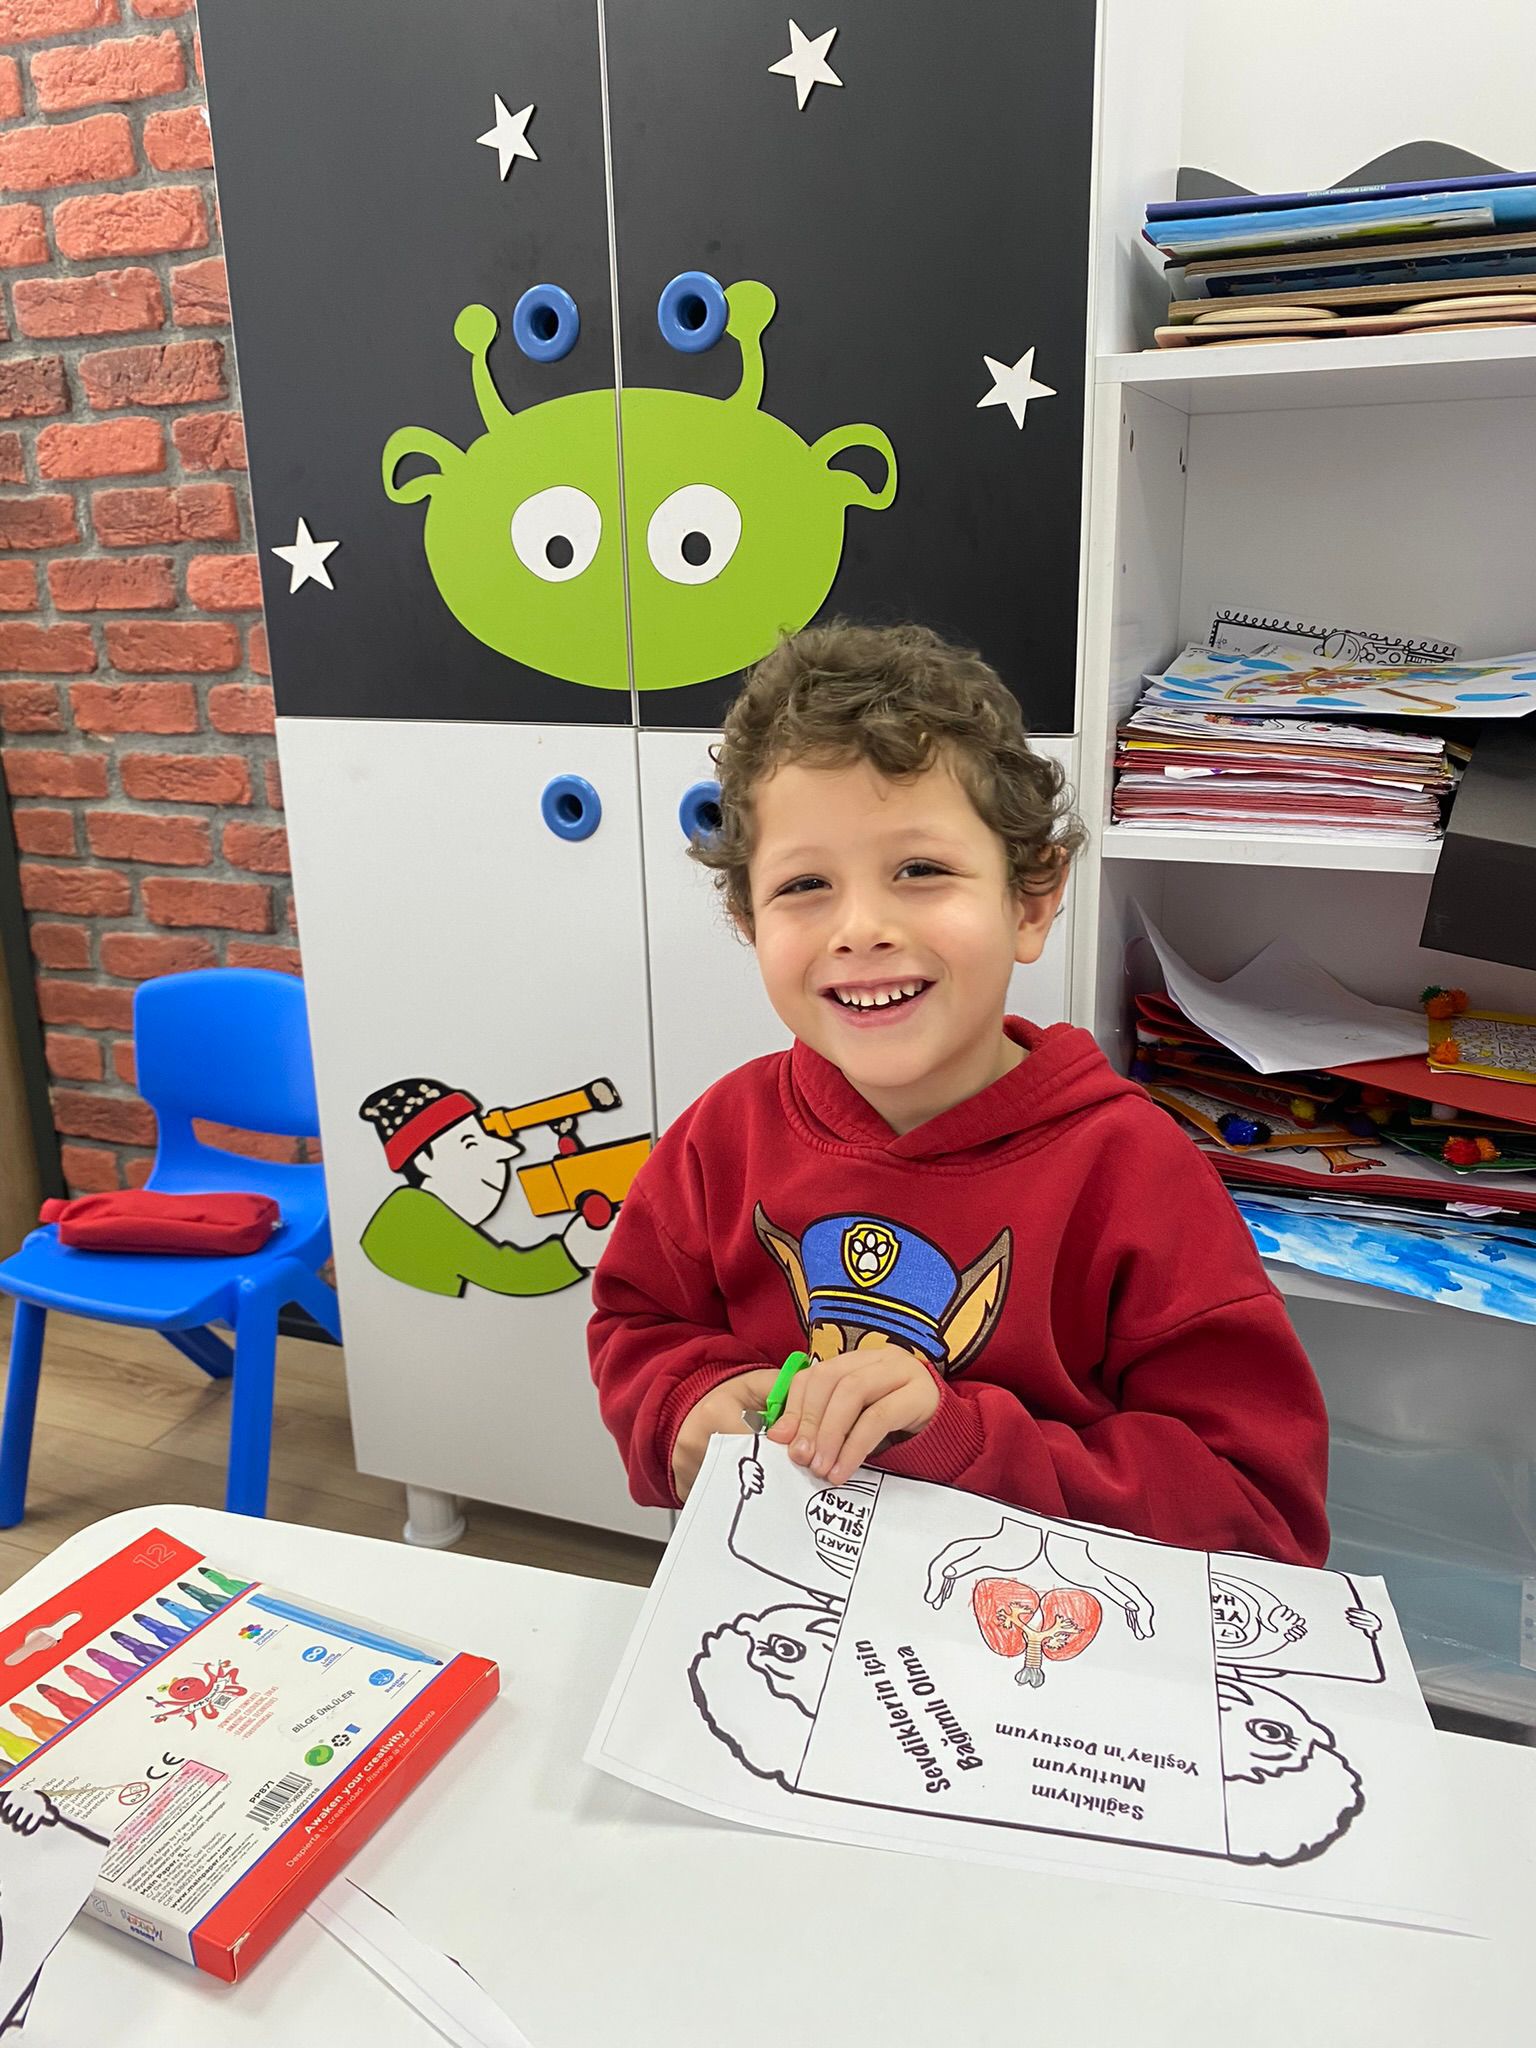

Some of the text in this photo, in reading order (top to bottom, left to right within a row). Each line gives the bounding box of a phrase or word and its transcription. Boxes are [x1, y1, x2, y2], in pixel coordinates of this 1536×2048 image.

[132, 1545, 176, 1568] 12
[818, 1534, 859, 1555] MART
[1213, 1609, 1243, 1622] YE
[1220, 1629, 1239, 1638] 1-7
[291, 1712, 318, 1733] BİLGE
[315, 1687, 355, 1717] ÜNLÜLER
[854, 1639, 951, 1794] Sevdiklerin için
[896, 1644, 983, 1771] Bağımlı Olma
[994, 1723, 1097, 1755] Dostuyum
[248, 1780, 275, 1803] PP871
[301, 1729, 407, 1834] Awaken your creativity
[1031, 1757, 1145, 1792] Mutluyum
[1031, 1784, 1144, 1819] Sağlıklıyım
[284, 1832, 322, 1867] Despierta
[317, 1824, 329, 1833] tu
[325, 1787, 364, 1824] creatividad
[139, 1879, 158, 1895] Main
[169, 1845, 233, 1908] www.mainpaper.com
